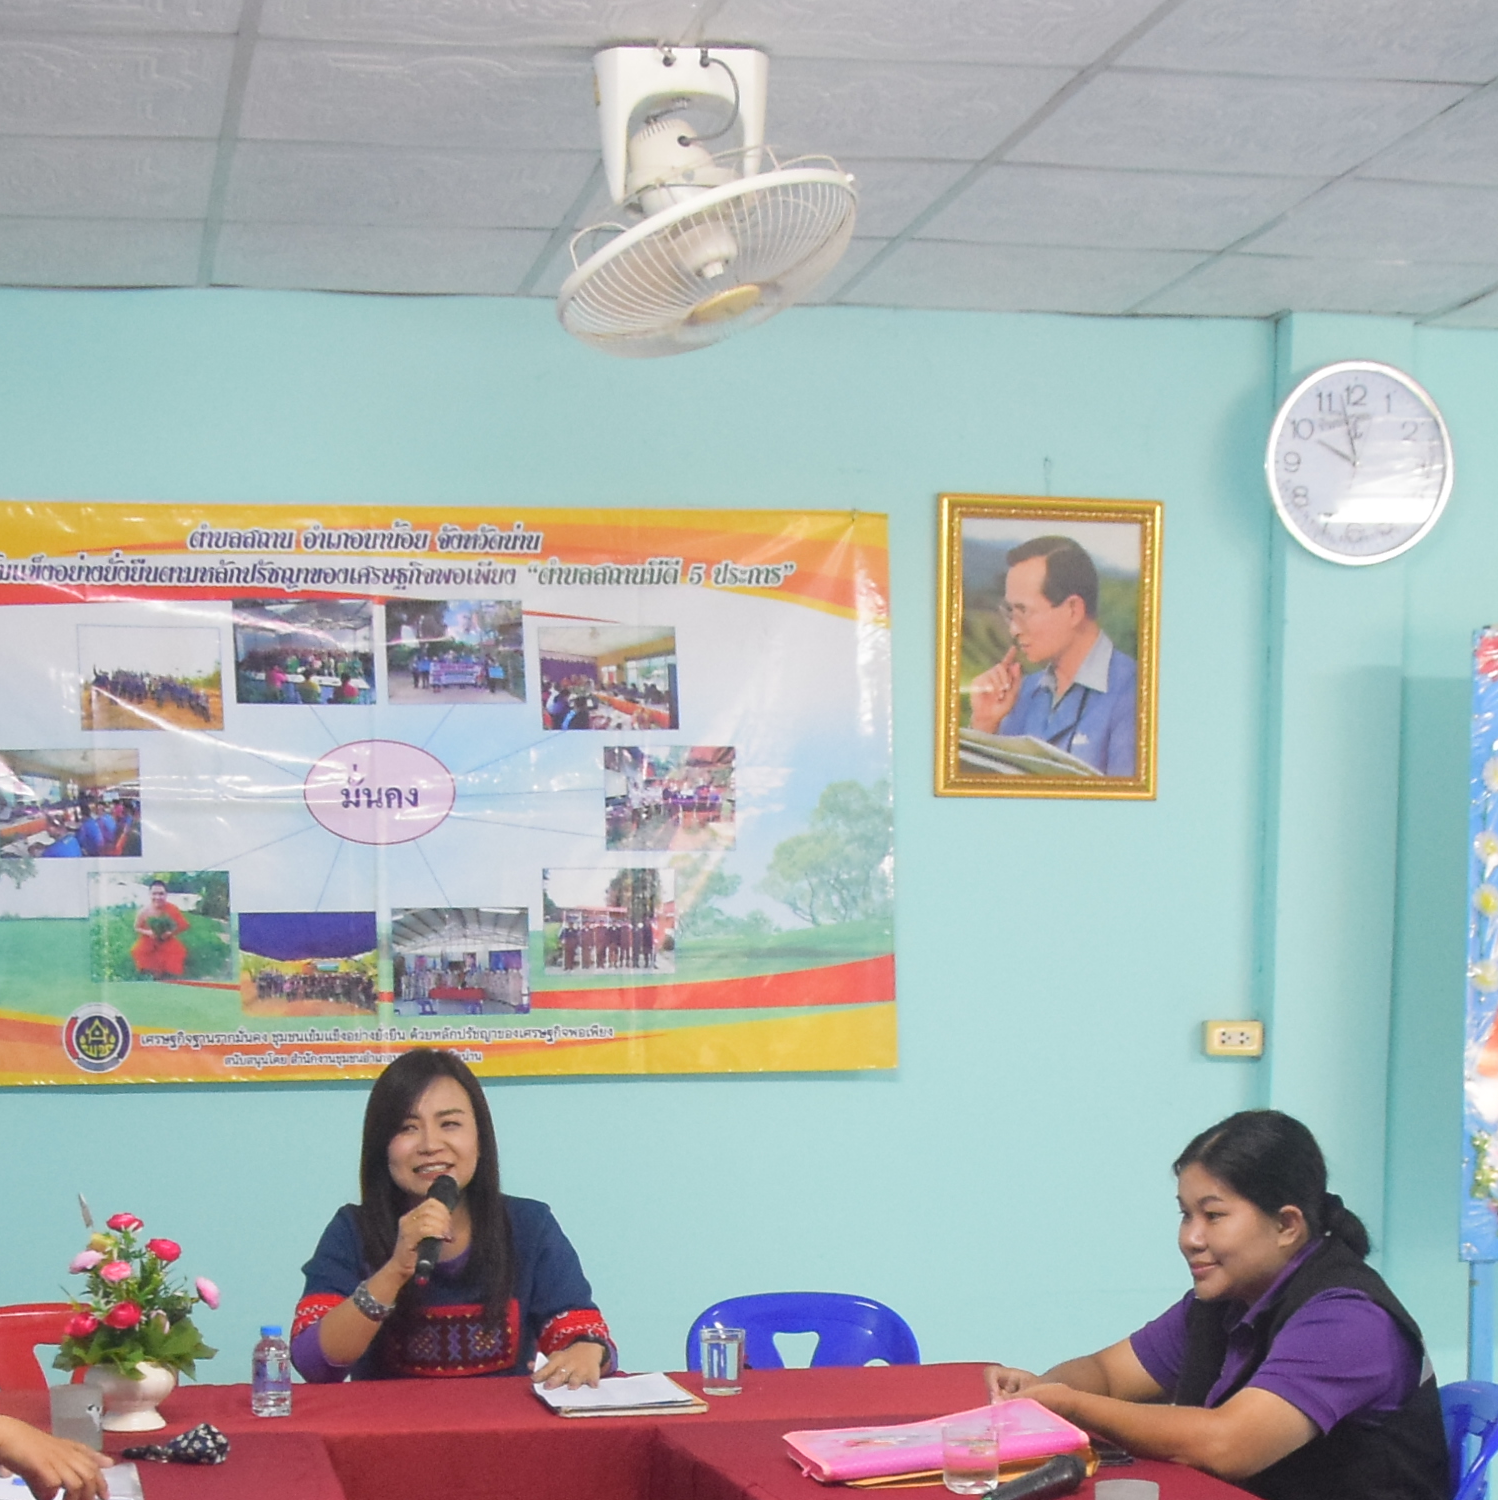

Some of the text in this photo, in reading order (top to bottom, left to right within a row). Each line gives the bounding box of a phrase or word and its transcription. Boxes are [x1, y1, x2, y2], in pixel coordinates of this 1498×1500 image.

[1316, 391, 1333, 412] 11
[1345, 384, 1368, 406] 12
[1290, 417, 1315, 441] 10
[1401, 421, 1419, 441] 2
[1283, 451, 1301, 473] 9
[1292, 485, 1309, 509] 8
[302, 521, 428, 553] อำเภอนาน้อย
[437, 523, 542, 553] จังหวัดน่าน
[688, 565, 705, 586] 5
[340, 764, 419, 810] มั่นคง
